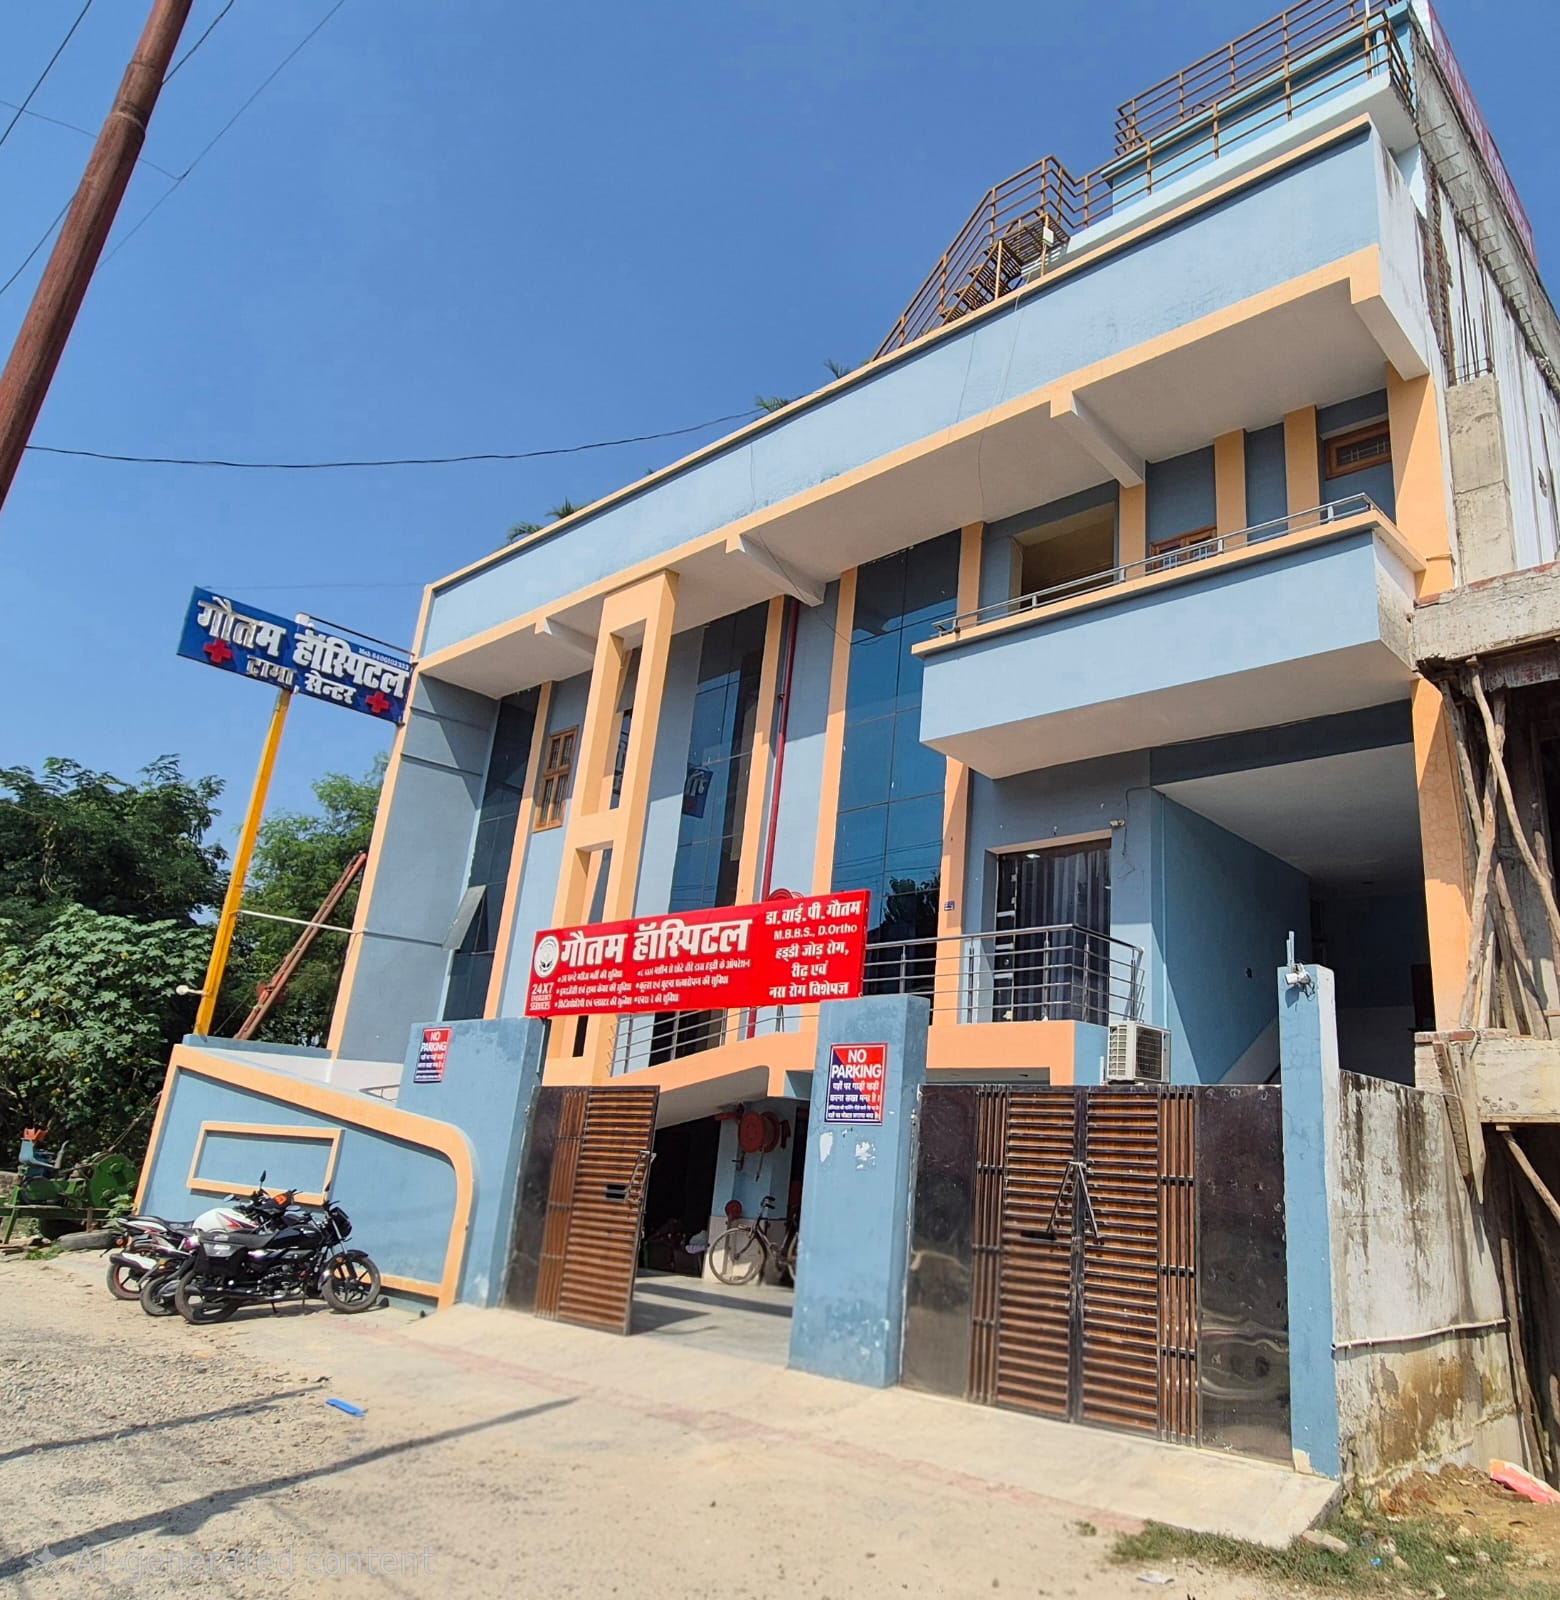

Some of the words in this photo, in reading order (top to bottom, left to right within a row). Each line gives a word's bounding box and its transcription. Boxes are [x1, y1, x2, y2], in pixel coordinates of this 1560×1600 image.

[197, 596, 287, 657] गौतम
[292, 629, 409, 698] हॉस्पिटल
[304, 669, 357, 705] सेन्टर
[818, 923, 858, 936] D.Ortho
[560, 930, 628, 967] गौतम
[633, 918, 752, 961] हॉस्पिटल
[801, 941, 824, 959] जोड़
[827, 939, 849, 956] रोग,
[791, 962, 809, 981] रीढ़
[811, 959, 829, 976] एवं
[789, 982, 807, 997] रोग
[430, 1031, 441, 1041] NO
[847, 1049, 867, 1063] NO
[831, 1064, 882, 1078] PARKING
